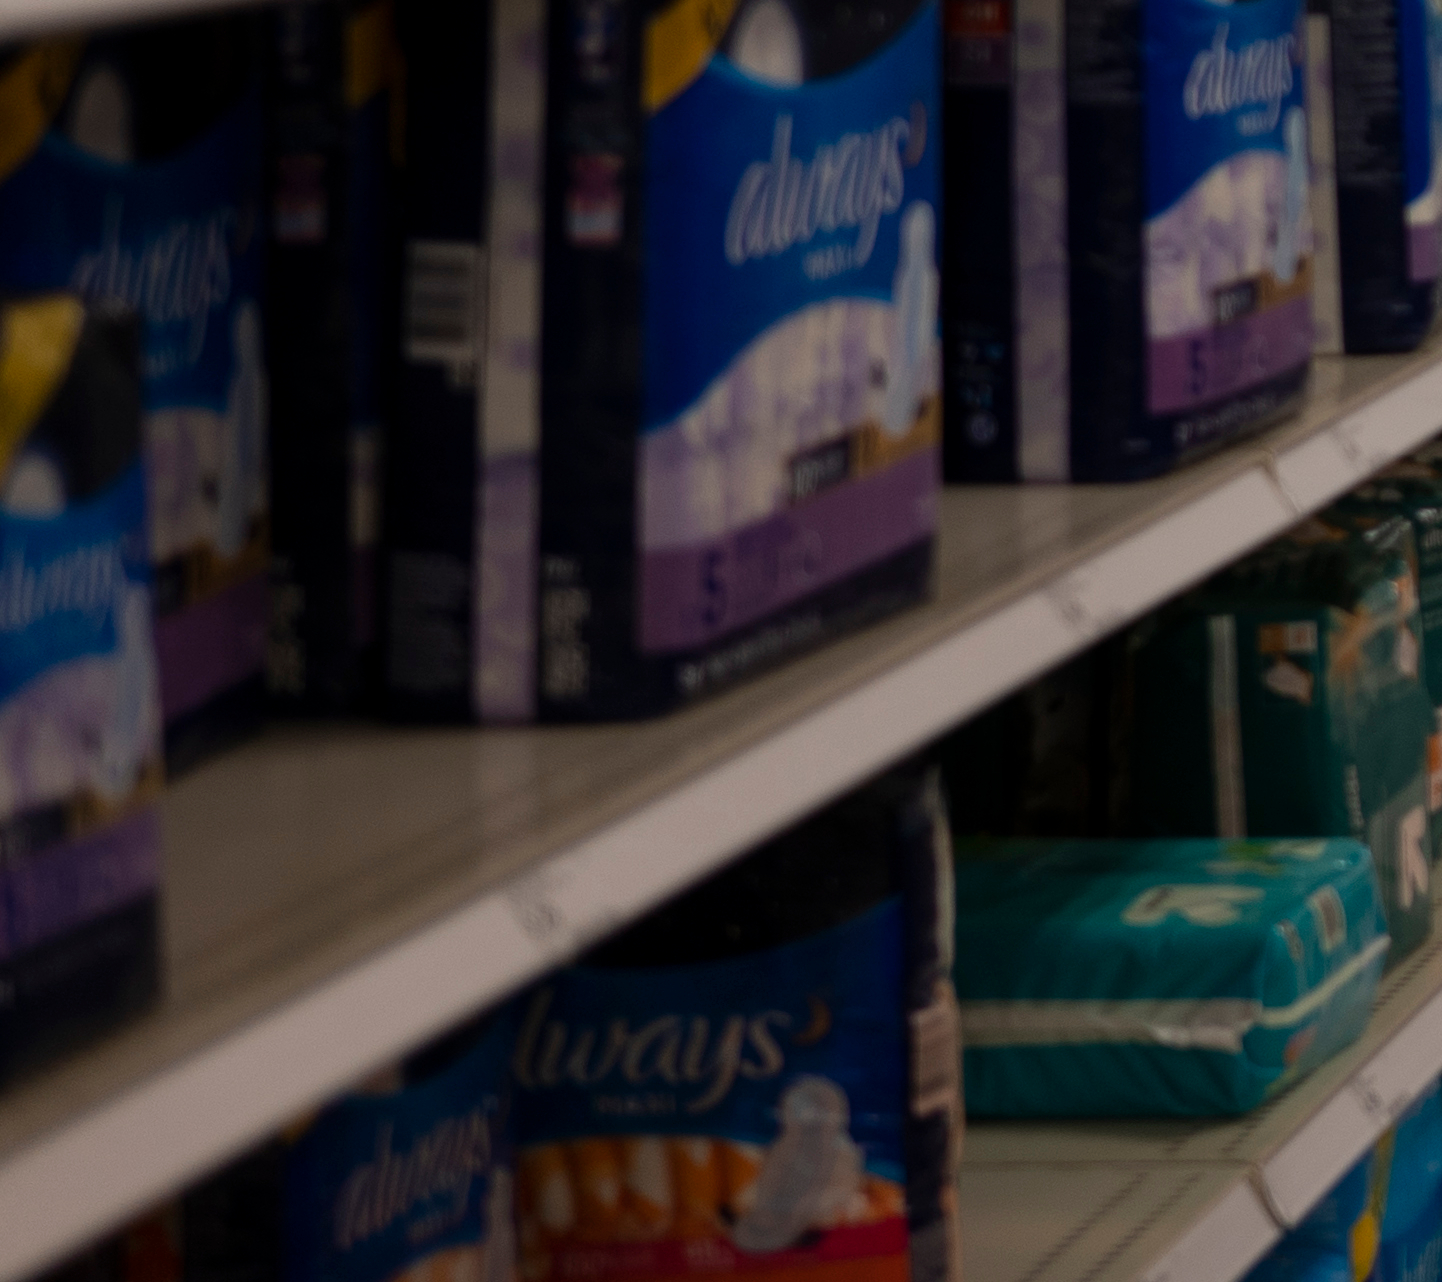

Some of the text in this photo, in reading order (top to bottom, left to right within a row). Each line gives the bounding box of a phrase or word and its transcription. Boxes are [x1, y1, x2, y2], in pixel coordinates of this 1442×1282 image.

[1186, 23, 1299, 122] always
[721, 109, 912, 272] always
[511, 986, 794, 1114] lways
